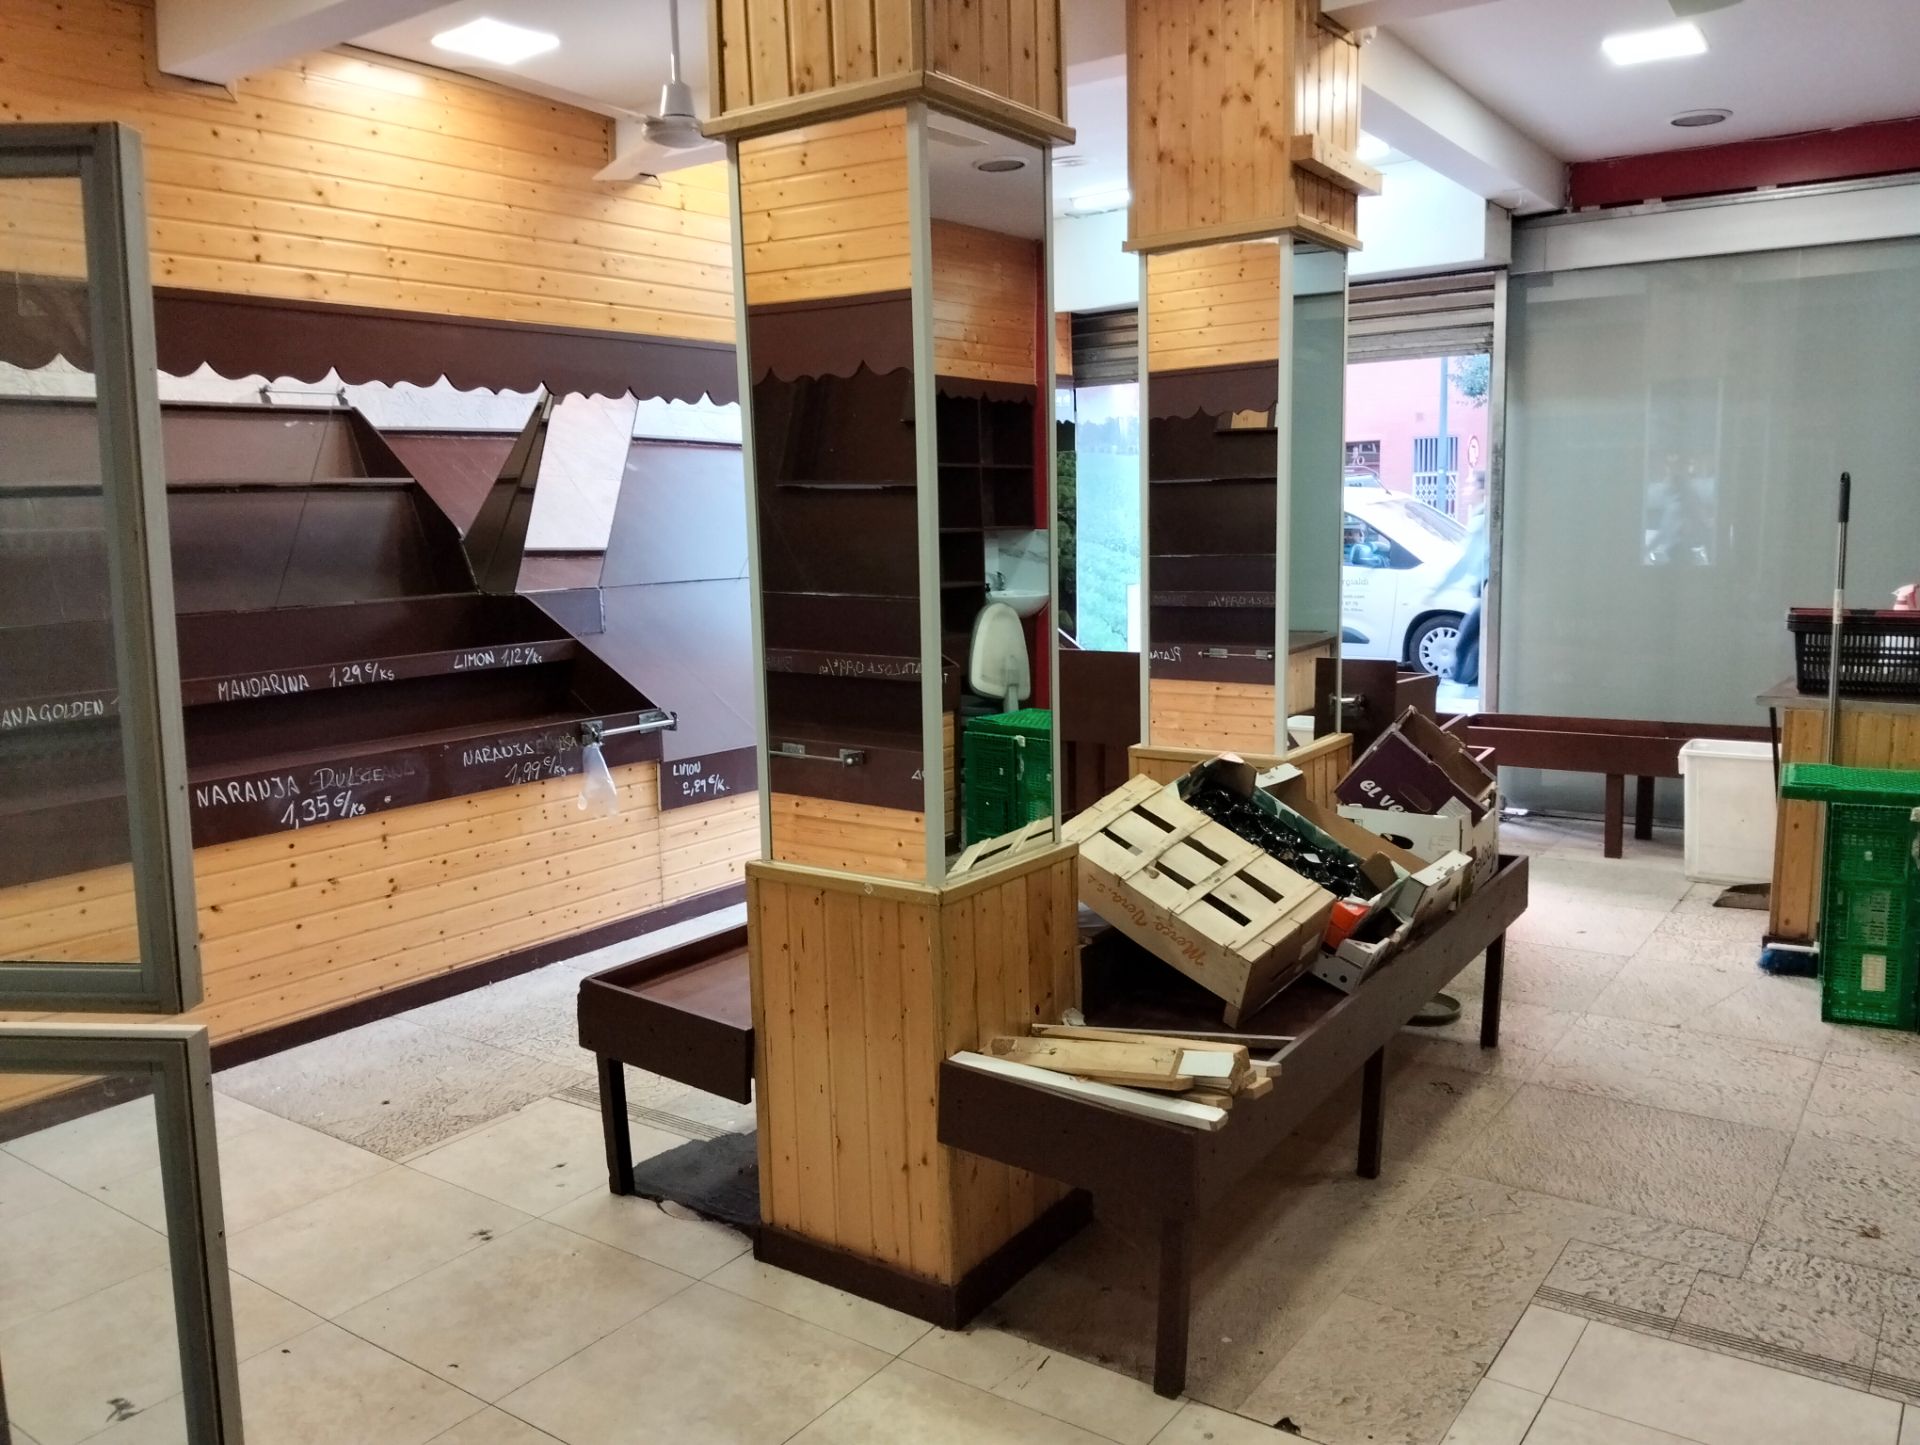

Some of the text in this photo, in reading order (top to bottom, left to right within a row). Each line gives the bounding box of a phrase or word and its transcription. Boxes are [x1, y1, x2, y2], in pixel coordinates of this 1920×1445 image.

[453, 650, 495, 669] LIMON
[217, 673, 310, 702] MANDARINA
[463, 743, 535, 768] NARANJA
[196, 775, 301, 808] NARANJA
